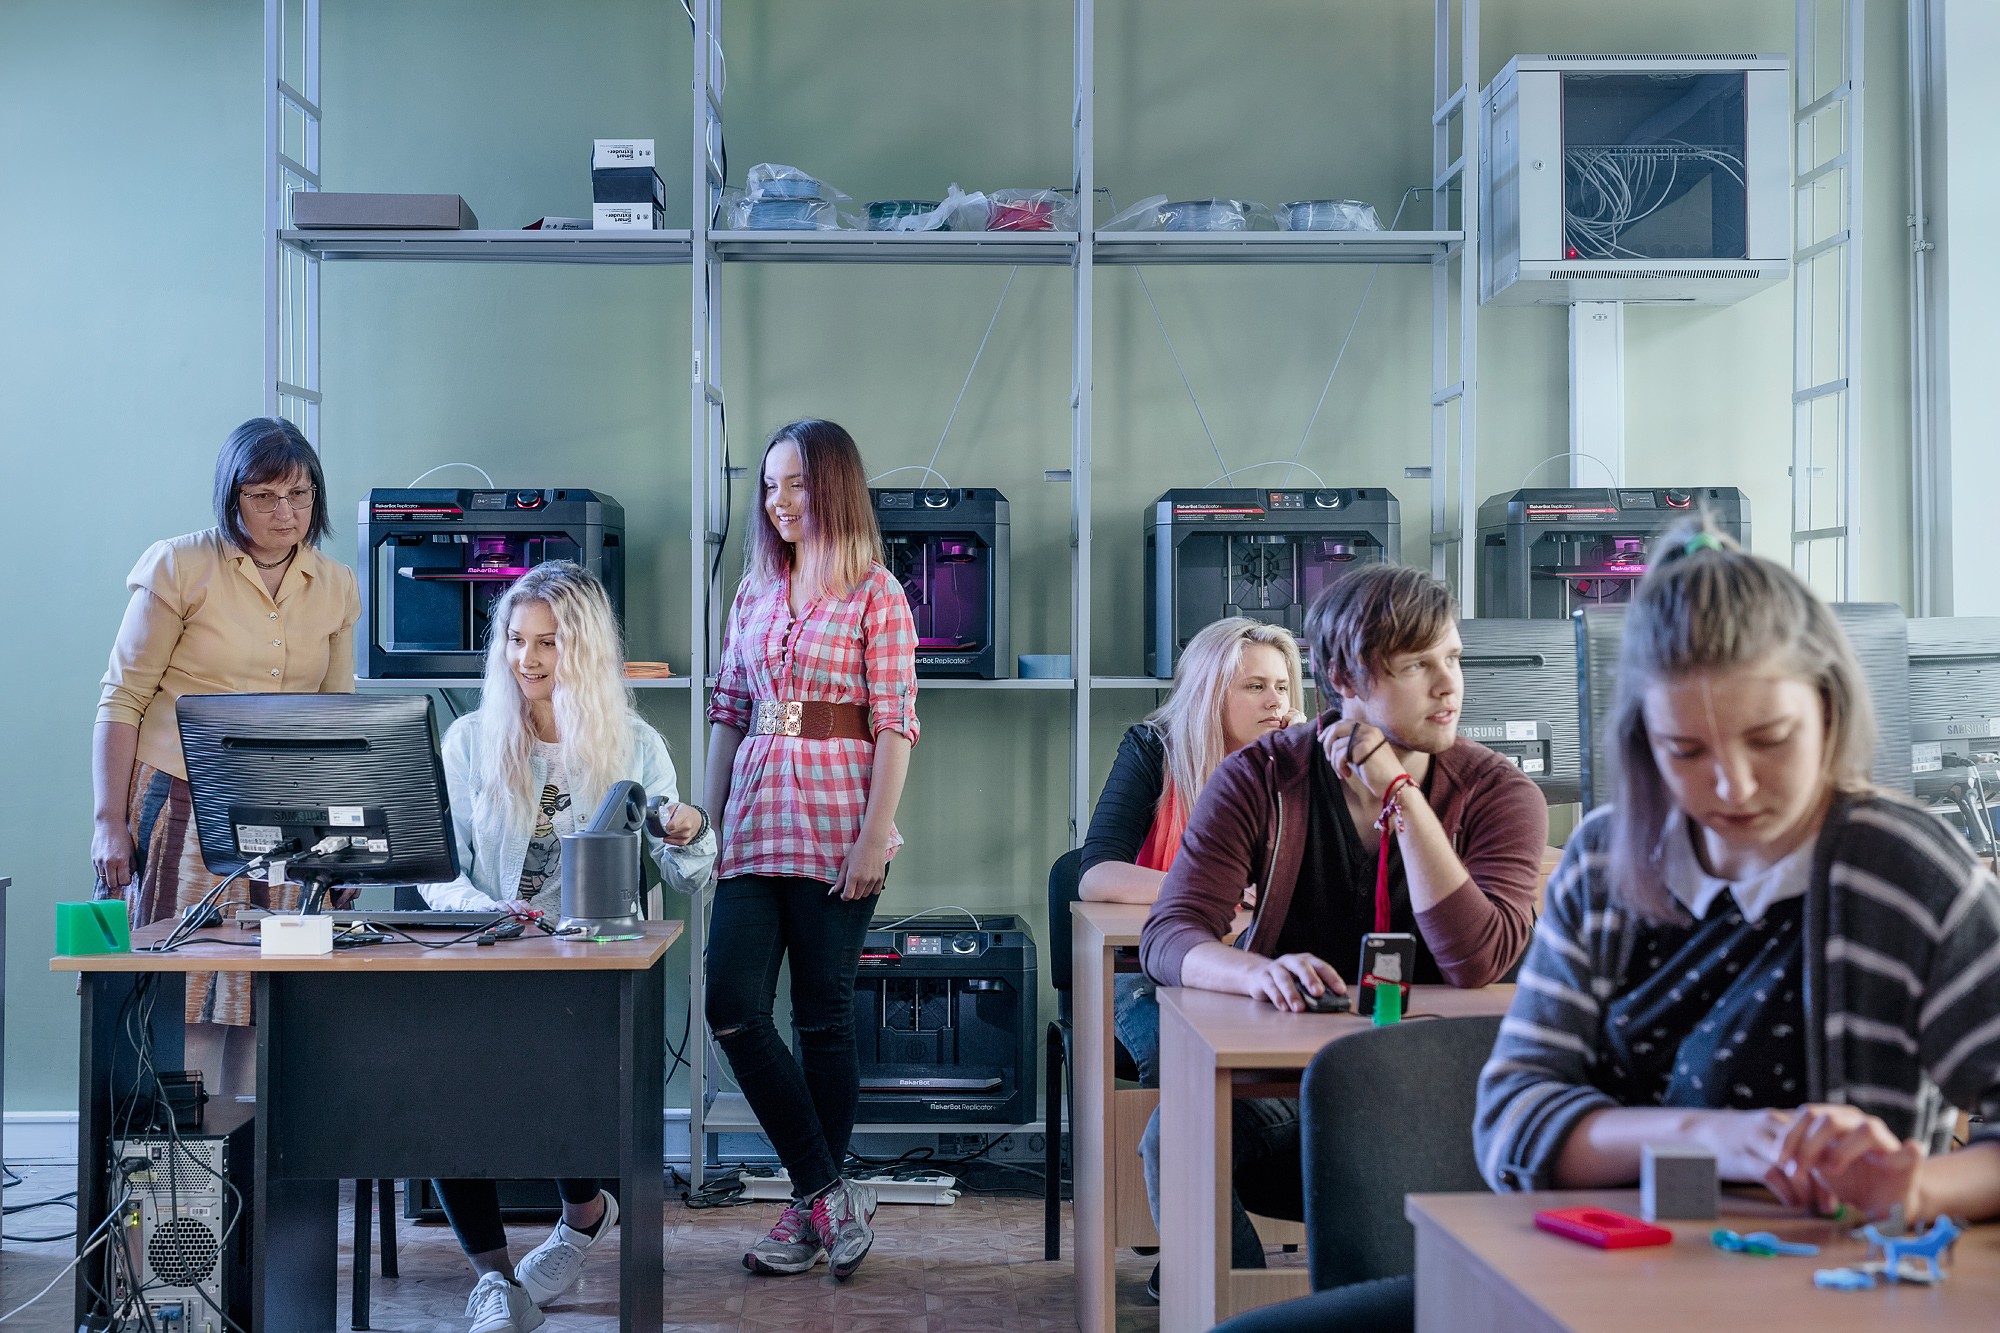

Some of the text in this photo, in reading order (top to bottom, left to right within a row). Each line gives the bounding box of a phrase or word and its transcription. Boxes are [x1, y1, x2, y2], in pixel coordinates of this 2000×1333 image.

[1464, 726, 1503, 737] MSUNG
[1947, 723, 1989, 735] SAMSUNG
[273, 811, 327, 822] SAMSUNG
